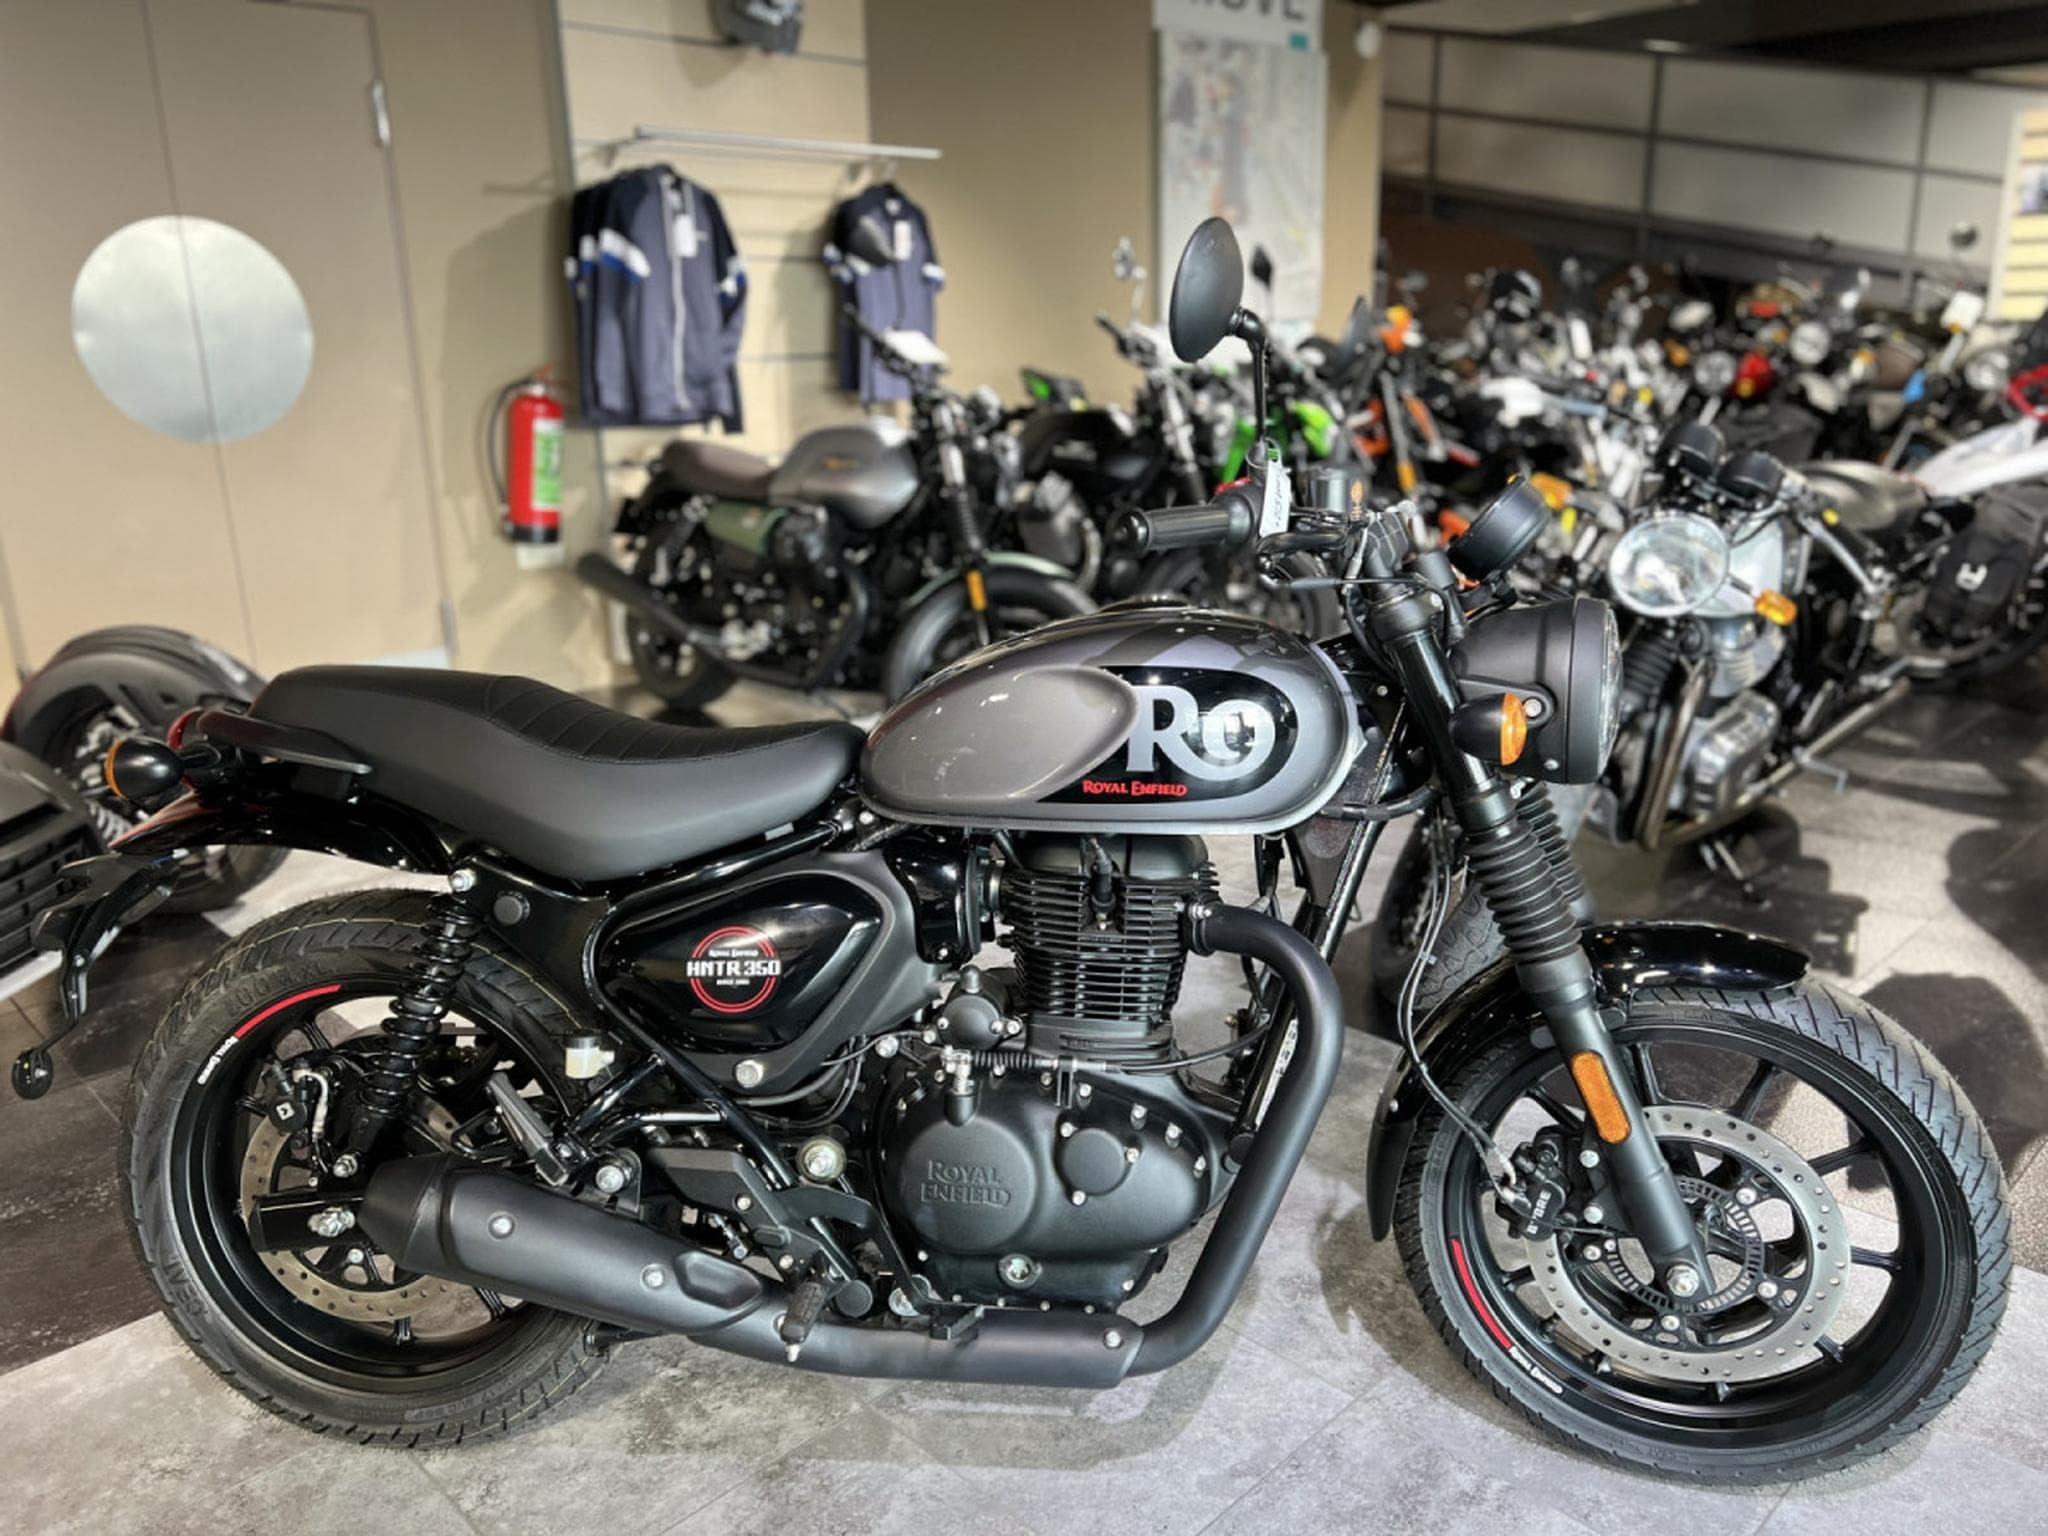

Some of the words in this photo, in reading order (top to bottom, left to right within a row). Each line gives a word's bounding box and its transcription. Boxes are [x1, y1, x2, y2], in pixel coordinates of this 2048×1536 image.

[1082, 780, 1129, 795] ROYAL
[1130, 780, 1188, 797] ENFIELD
[686, 959, 742, 977] HNTR
[743, 959, 781, 976] 350
[927, 1159, 1002, 1187] ROYAL
[920, 1182, 1012, 1209] ENFIELD
